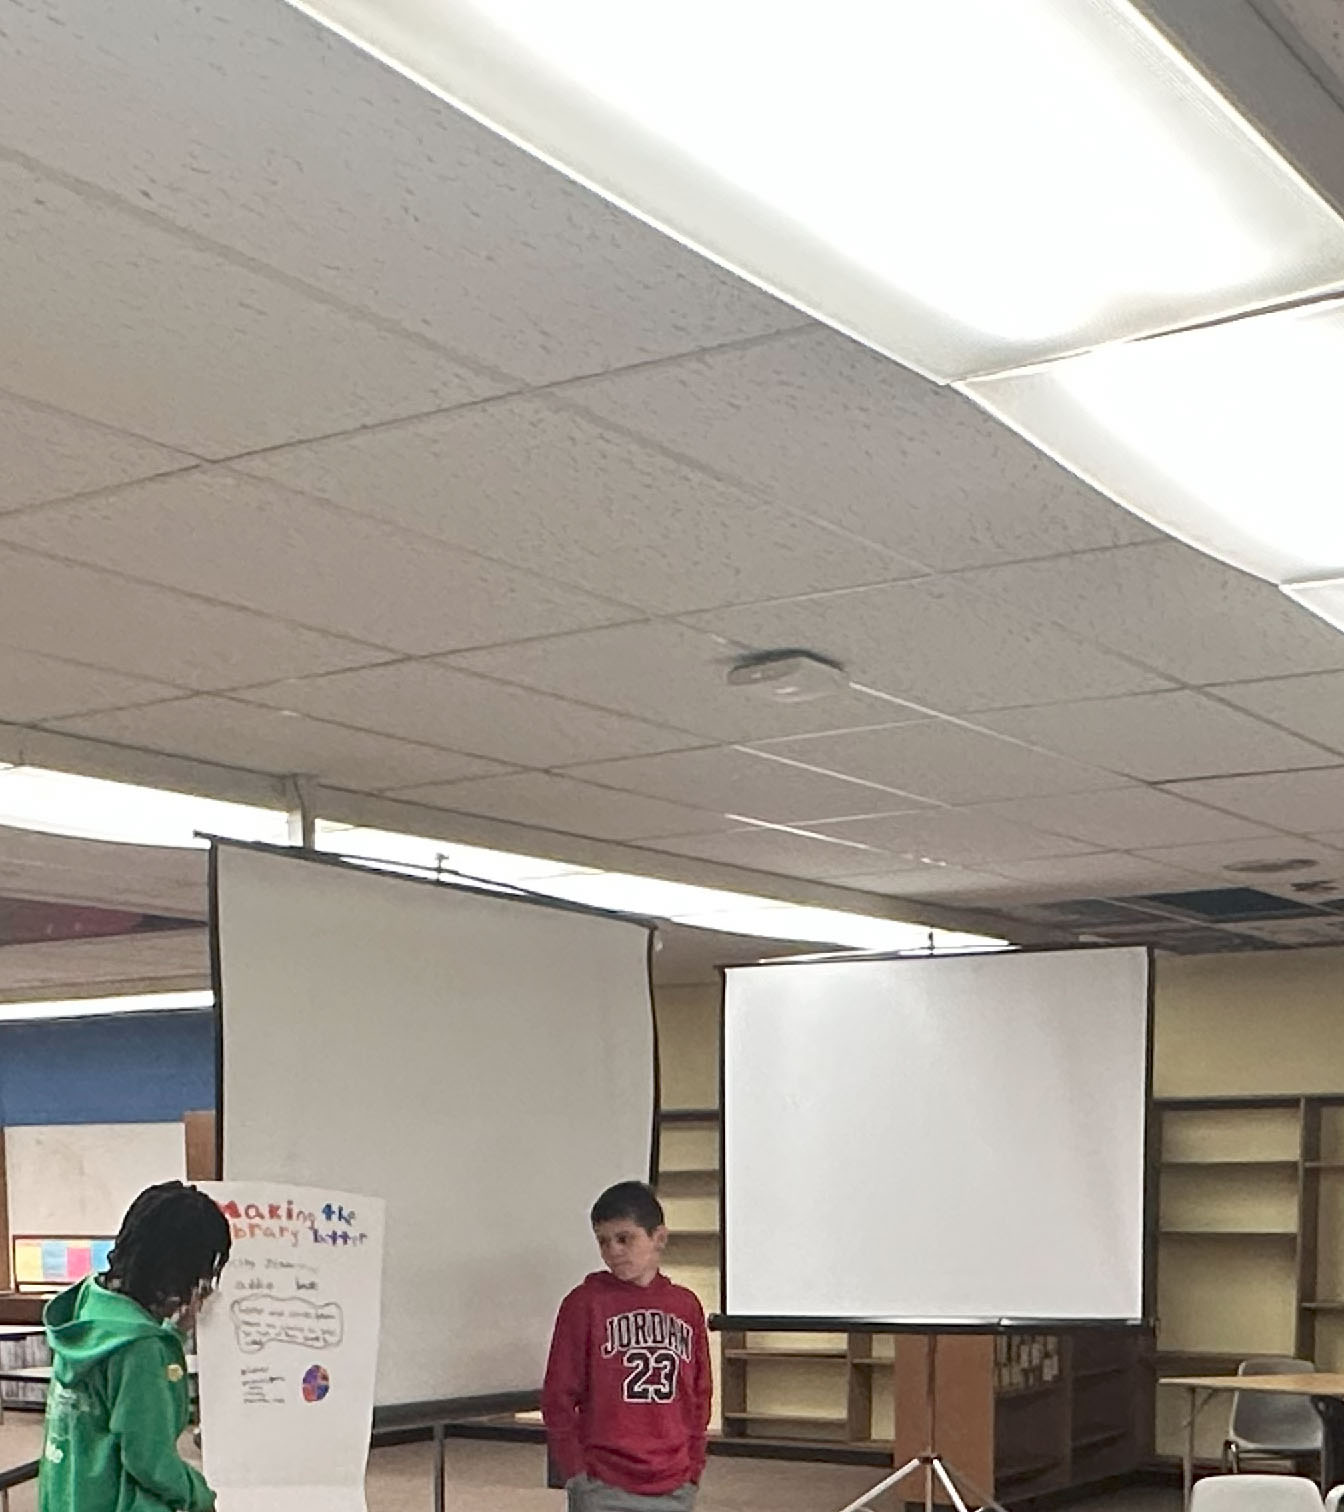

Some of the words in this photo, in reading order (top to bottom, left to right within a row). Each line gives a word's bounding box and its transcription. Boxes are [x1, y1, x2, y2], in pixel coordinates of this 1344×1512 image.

[321, 1203, 356, 1226] the
[231, 1222, 299, 1248] brary
[601, 1309, 693, 1363] JORDAN
[622, 1349, 679, 1404] 23
